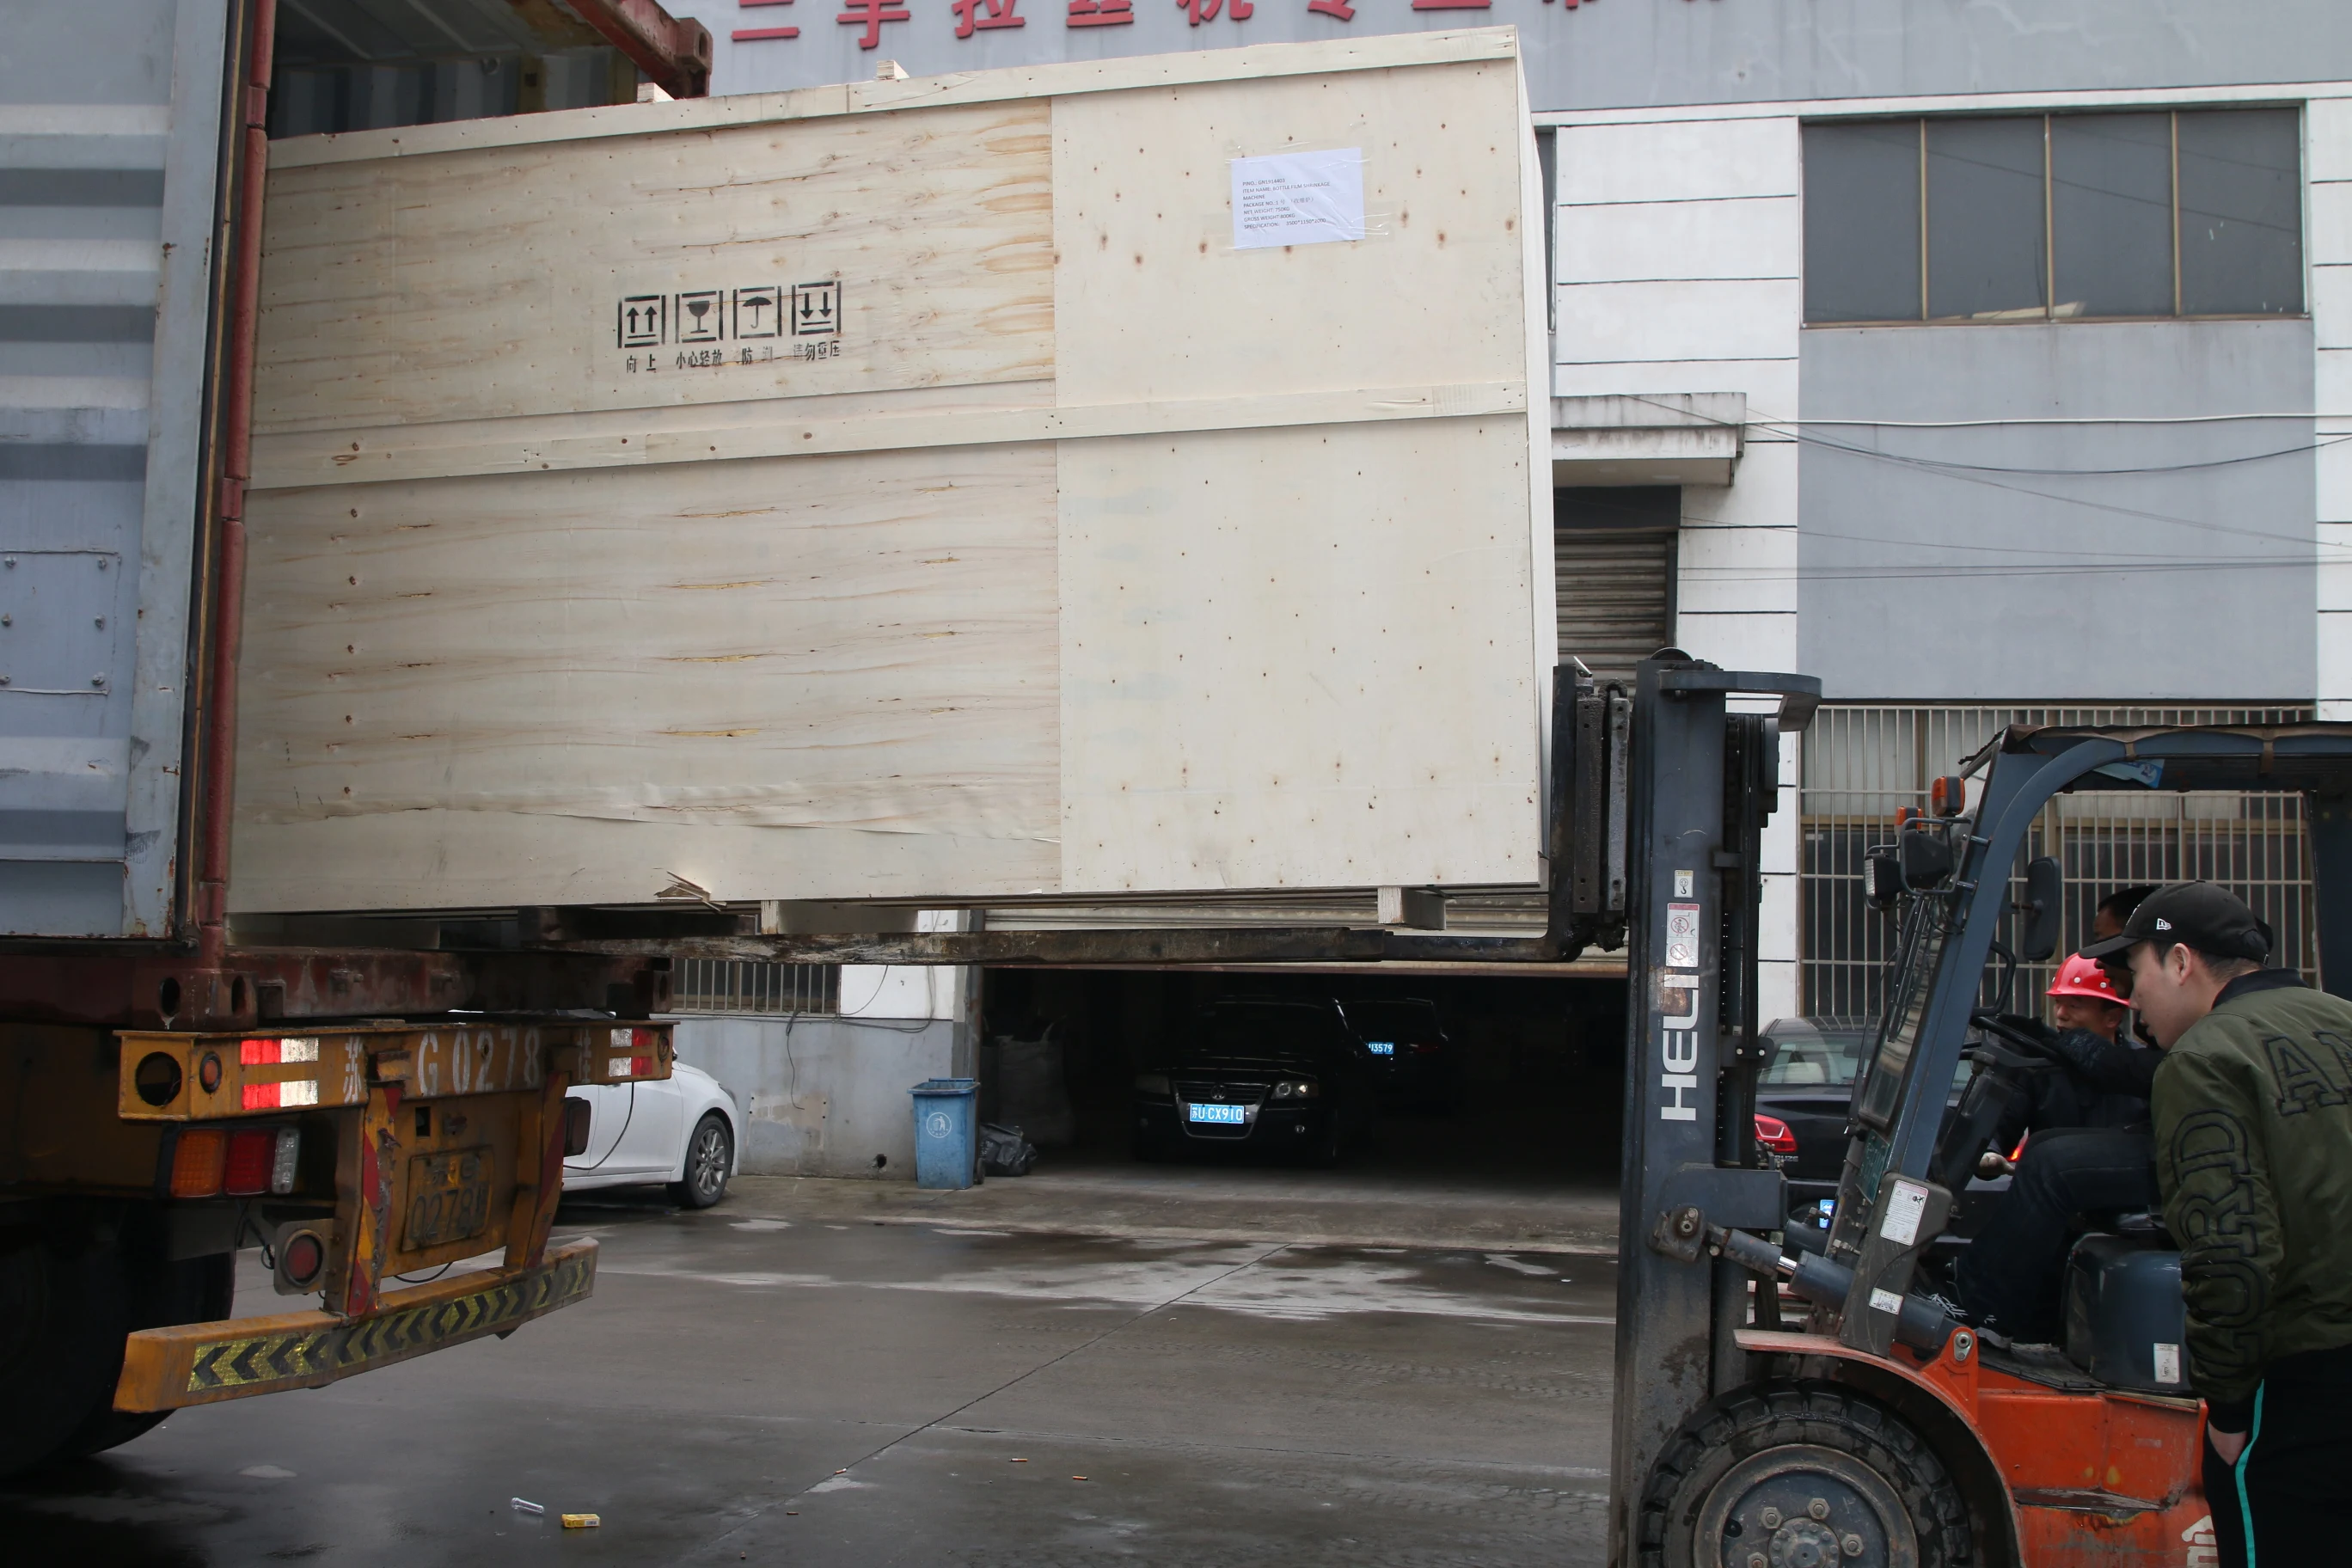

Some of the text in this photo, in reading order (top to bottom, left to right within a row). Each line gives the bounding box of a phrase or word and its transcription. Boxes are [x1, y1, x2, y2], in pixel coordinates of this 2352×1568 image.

[676, 349, 723, 370] 小心轻放
[1661, 974, 1700, 1122] HELI
